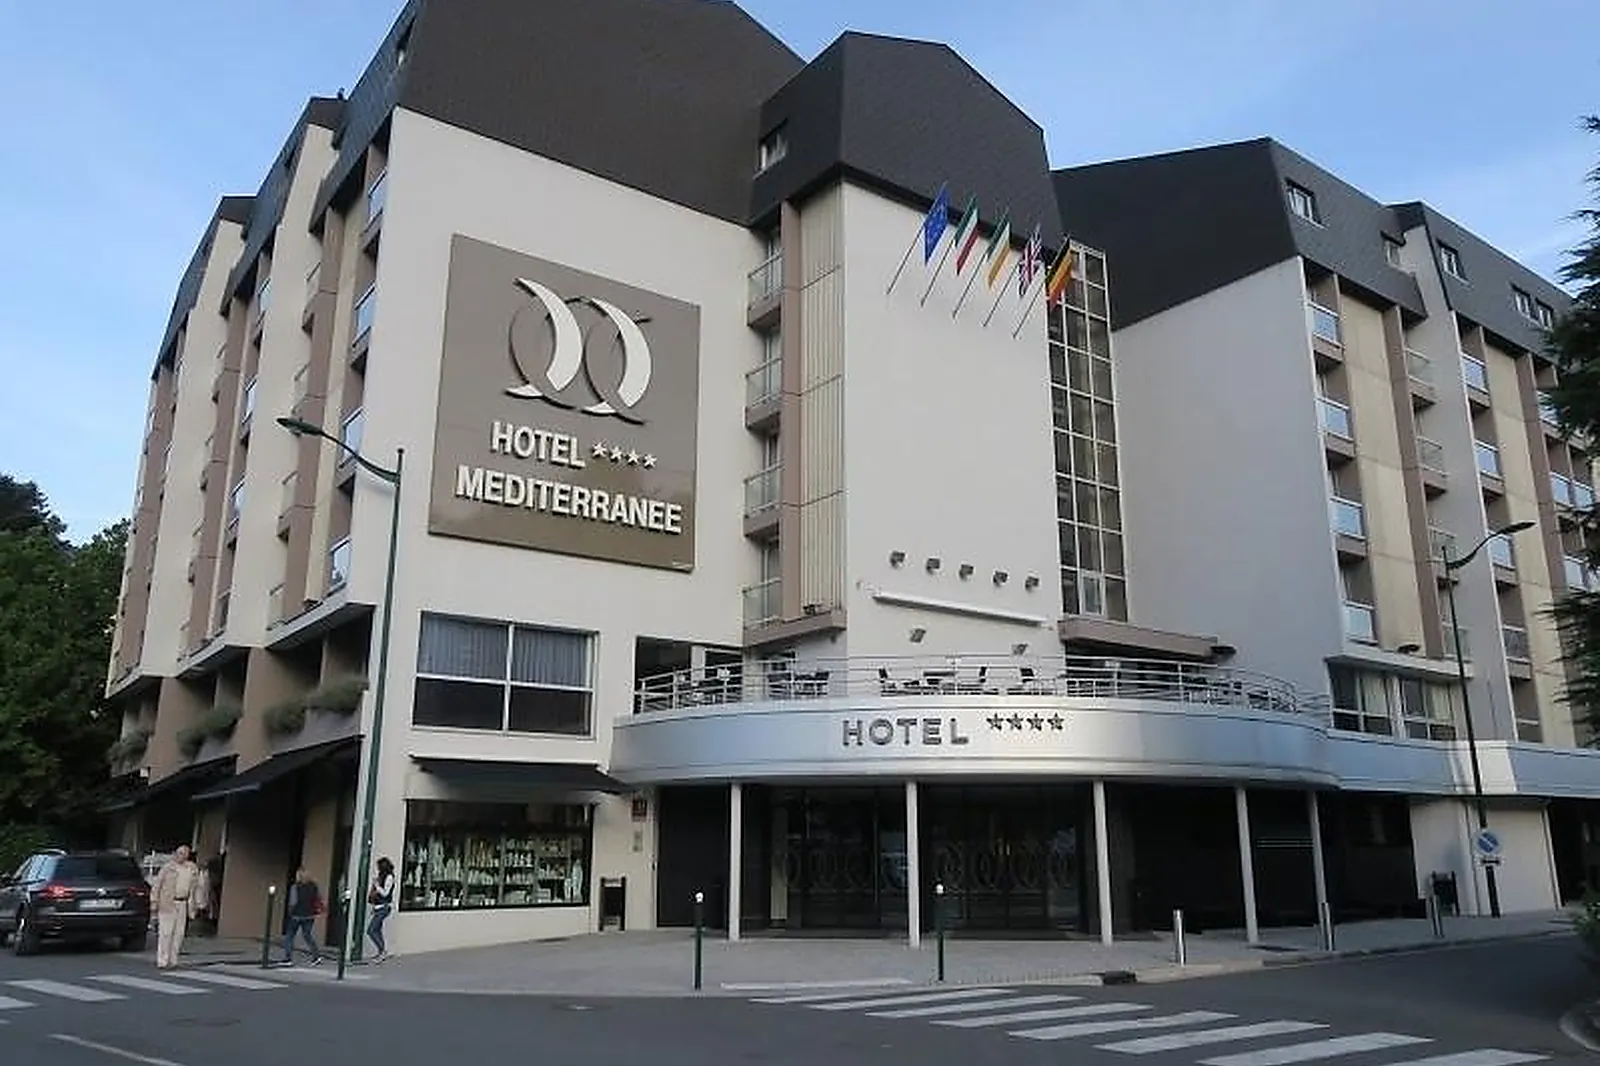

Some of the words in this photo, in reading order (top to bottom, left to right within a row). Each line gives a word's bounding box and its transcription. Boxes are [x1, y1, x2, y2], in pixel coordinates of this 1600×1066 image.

[491, 421, 586, 468] HOTEL
[455, 464, 682, 534] MEDITERRANEE
[842, 718, 969, 746] HOTEL
